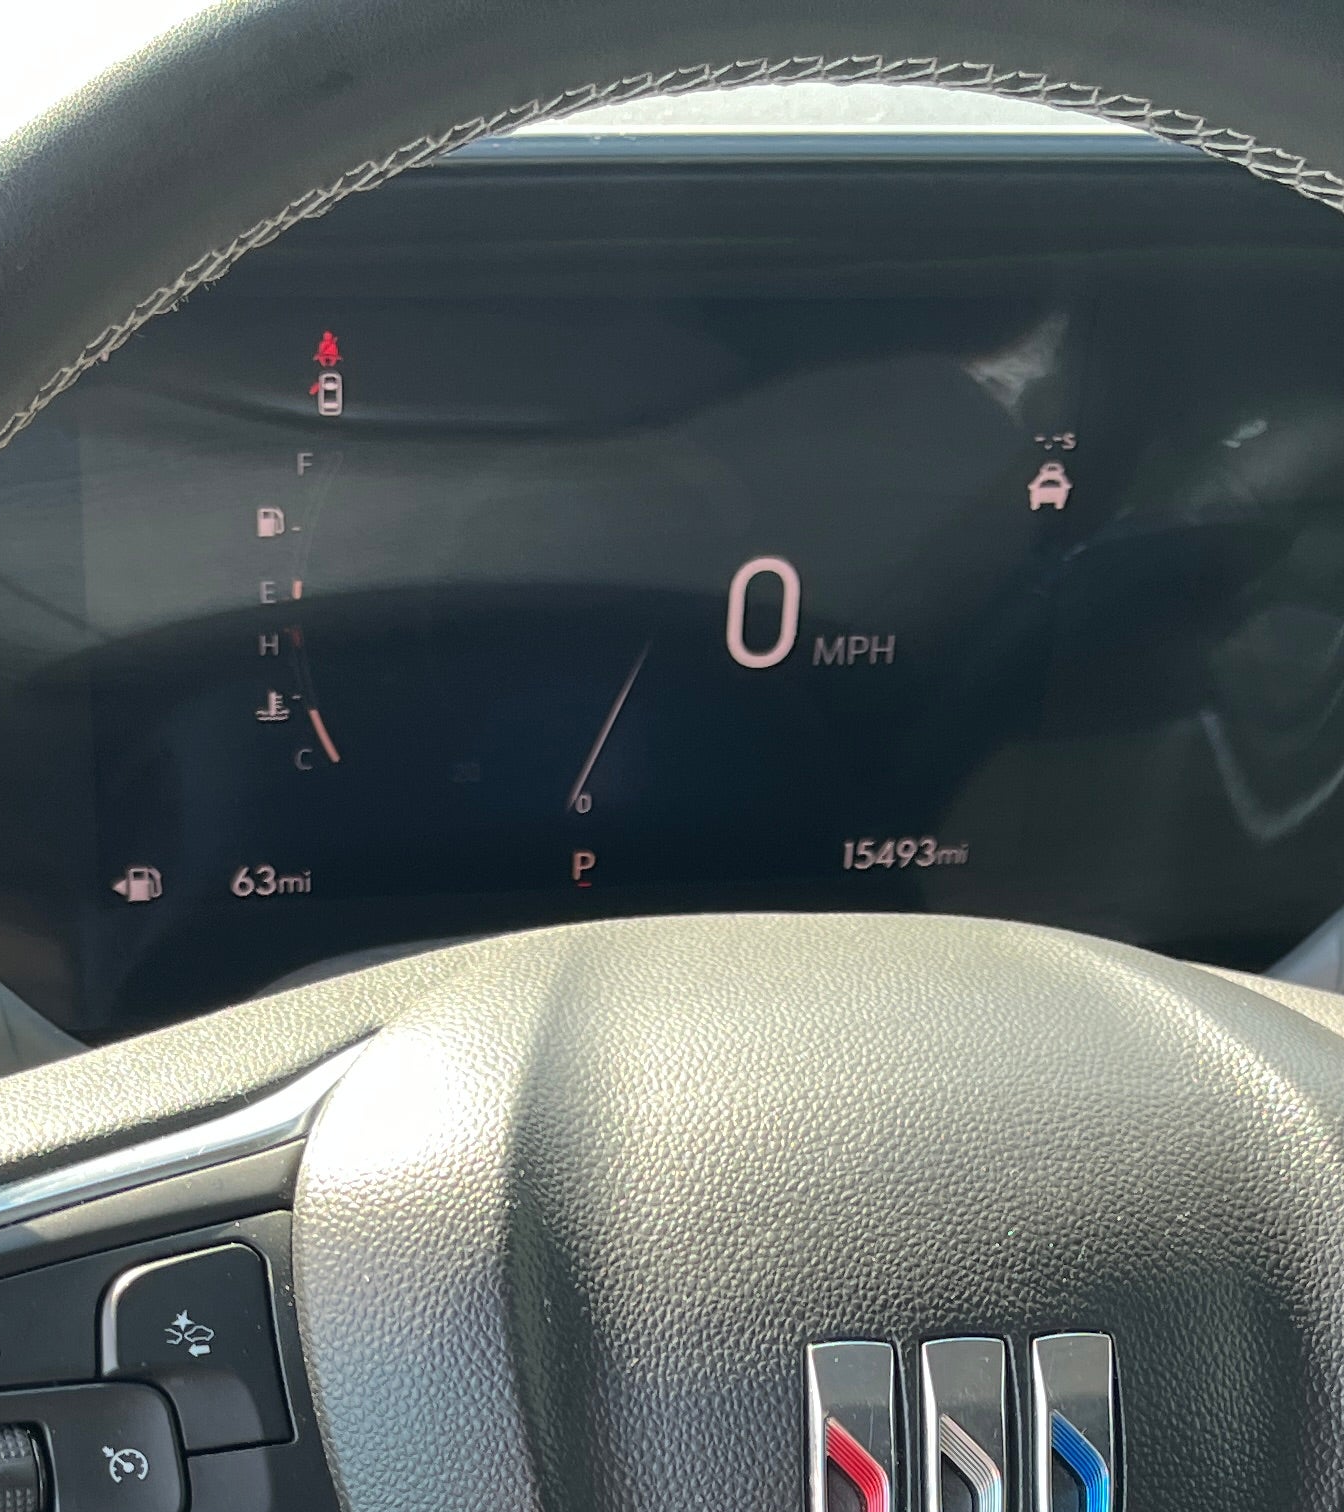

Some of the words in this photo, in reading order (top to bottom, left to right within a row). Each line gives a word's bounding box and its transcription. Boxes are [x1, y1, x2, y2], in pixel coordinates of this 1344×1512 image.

[296, 452, 313, 476] F
[259, 581, 276, 604] E
[726, 557, 801, 669] 0
[812, 634, 896, 667] MPH
[259, 634, 279, 656] H
[295, 749, 313, 771] C
[572, 851, 596, 881] P
